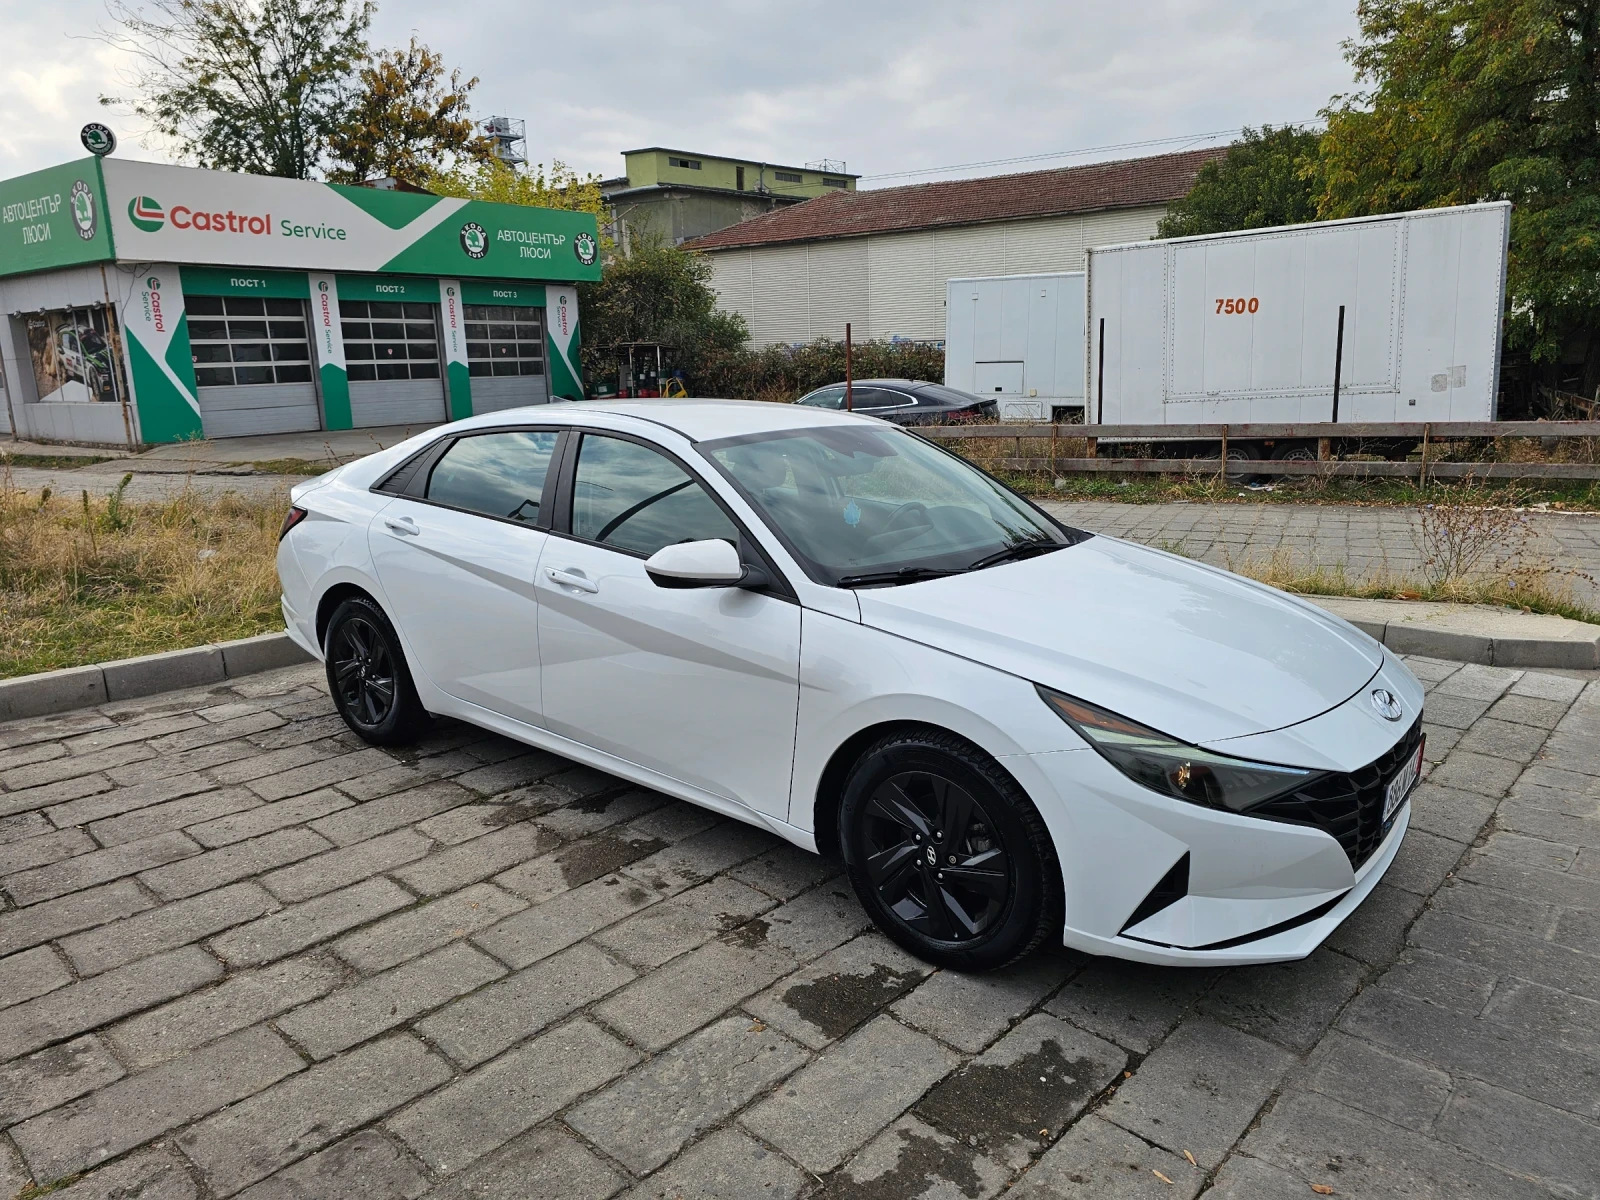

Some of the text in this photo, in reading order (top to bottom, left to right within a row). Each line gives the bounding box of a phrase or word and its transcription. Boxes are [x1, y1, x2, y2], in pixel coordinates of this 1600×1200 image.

[2, 193, 62, 224] АВТОЦЕНТЪР
[22, 222, 52, 245] ЛЮСИ
[170, 205, 347, 241] Castrol Service
[497, 229, 566, 246] АВТОЦЕНТЪР
[519, 246, 552, 260] ЛЮСИ
[230, 278, 266, 288] ПОСТ 1
[375, 284, 399, 293] ПОСТ
[492, 290, 512, 298] ПОСТ
[141, 291, 152, 322] Service
[150, 291, 166, 333] Castrol
[448, 298, 457, 329] Castrol
[1215, 297, 1260, 315] 7500
[320, 293, 333, 354] Castrol Service
[561, 306, 569, 336] Castrol
